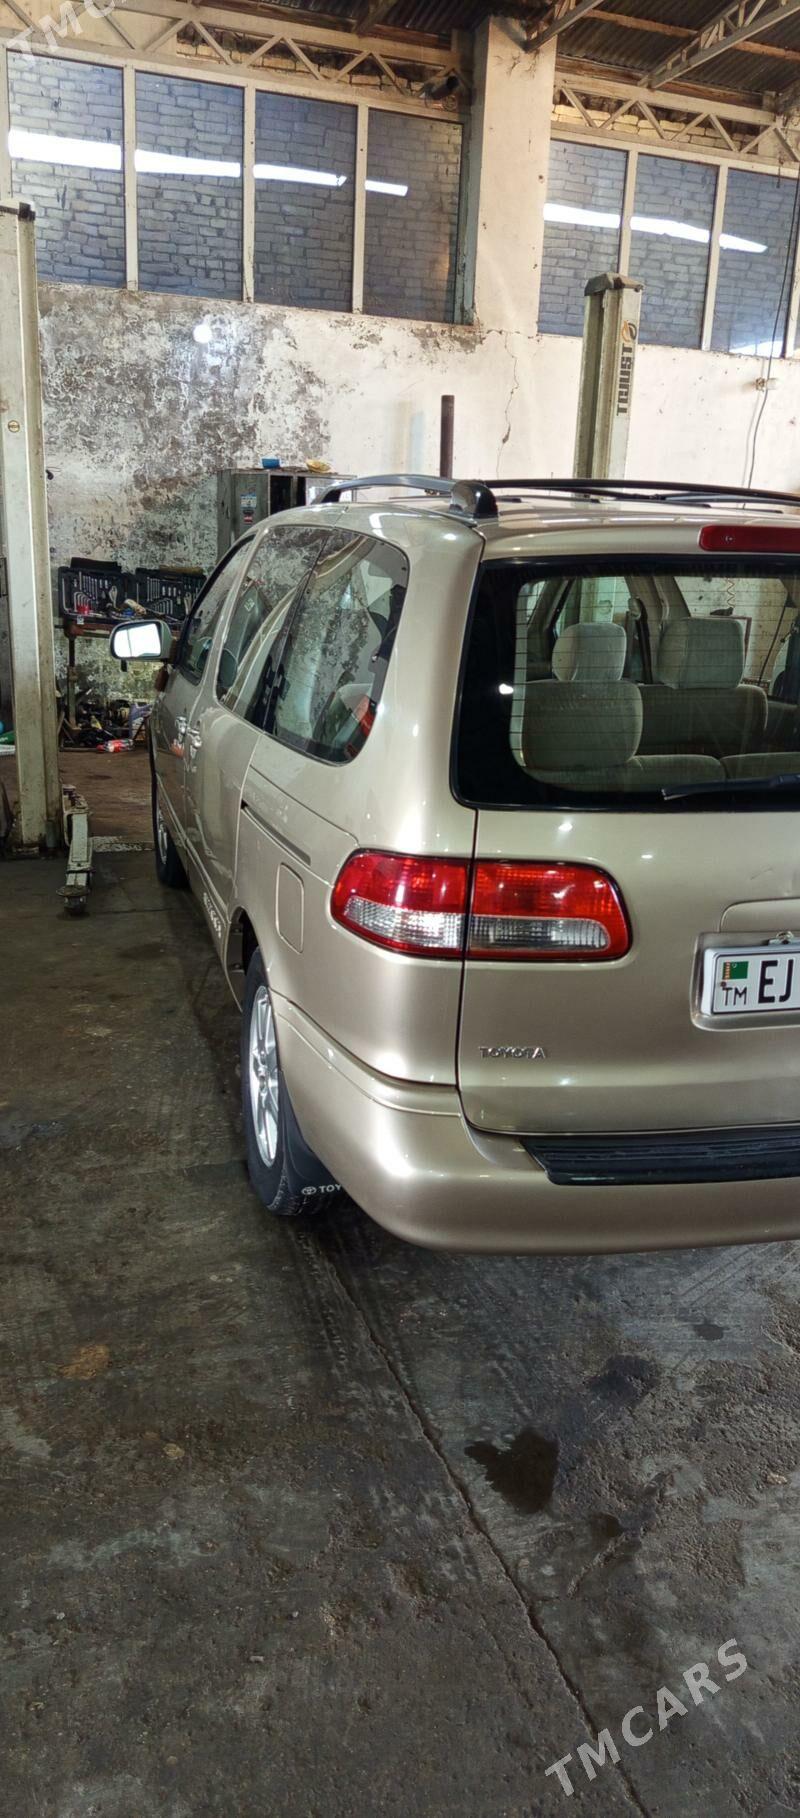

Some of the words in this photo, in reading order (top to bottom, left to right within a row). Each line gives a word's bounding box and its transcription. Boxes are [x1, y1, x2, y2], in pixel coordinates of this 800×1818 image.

[721, 986, 747, 1006] TM
[758, 959, 794, 1004] EJ
[478, 1046, 546, 1059] TOYOTA
[319, 1183, 342, 1193] TOY
